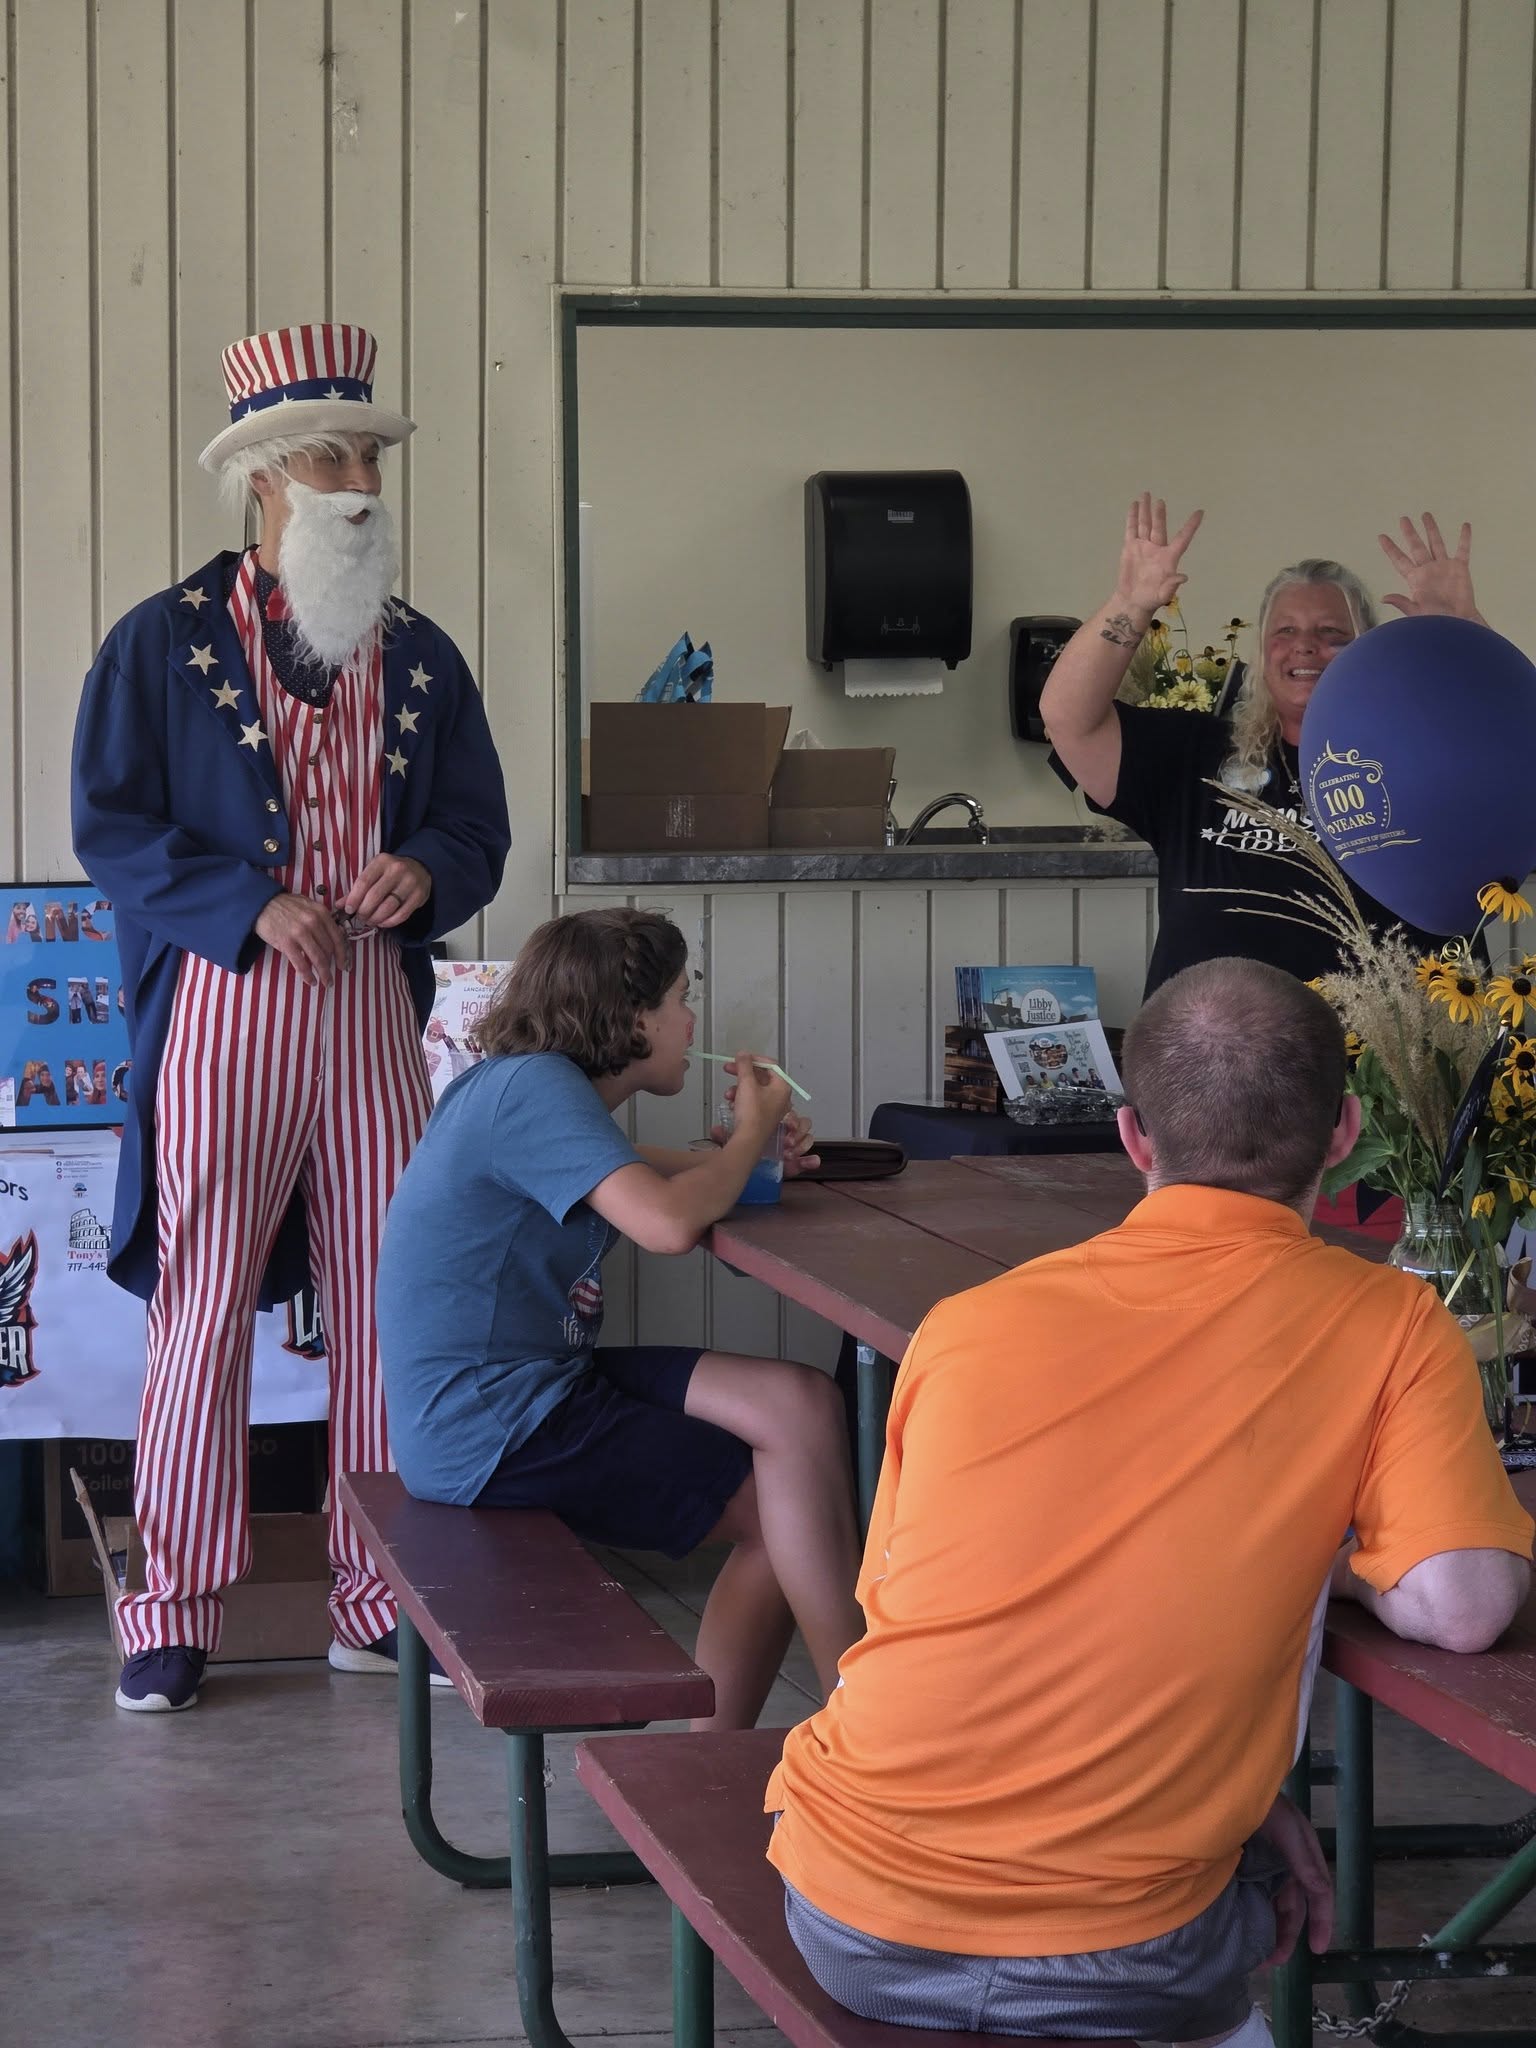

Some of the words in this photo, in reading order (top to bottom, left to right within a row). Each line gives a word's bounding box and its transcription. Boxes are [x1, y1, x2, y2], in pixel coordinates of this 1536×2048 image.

[1319, 772, 1360, 788] CELEBRATING
[1323, 784, 1365, 817] 100
[1332, 811, 1377, 833] YEARS
[26, 976, 125, 1025] SN
[1028, 998, 1053, 1011] Libby
[1027, 1010, 1056, 1023] Justice
[67, 1250, 103, 1262] Tony's
[67, 1262, 107, 1272] 717-445
